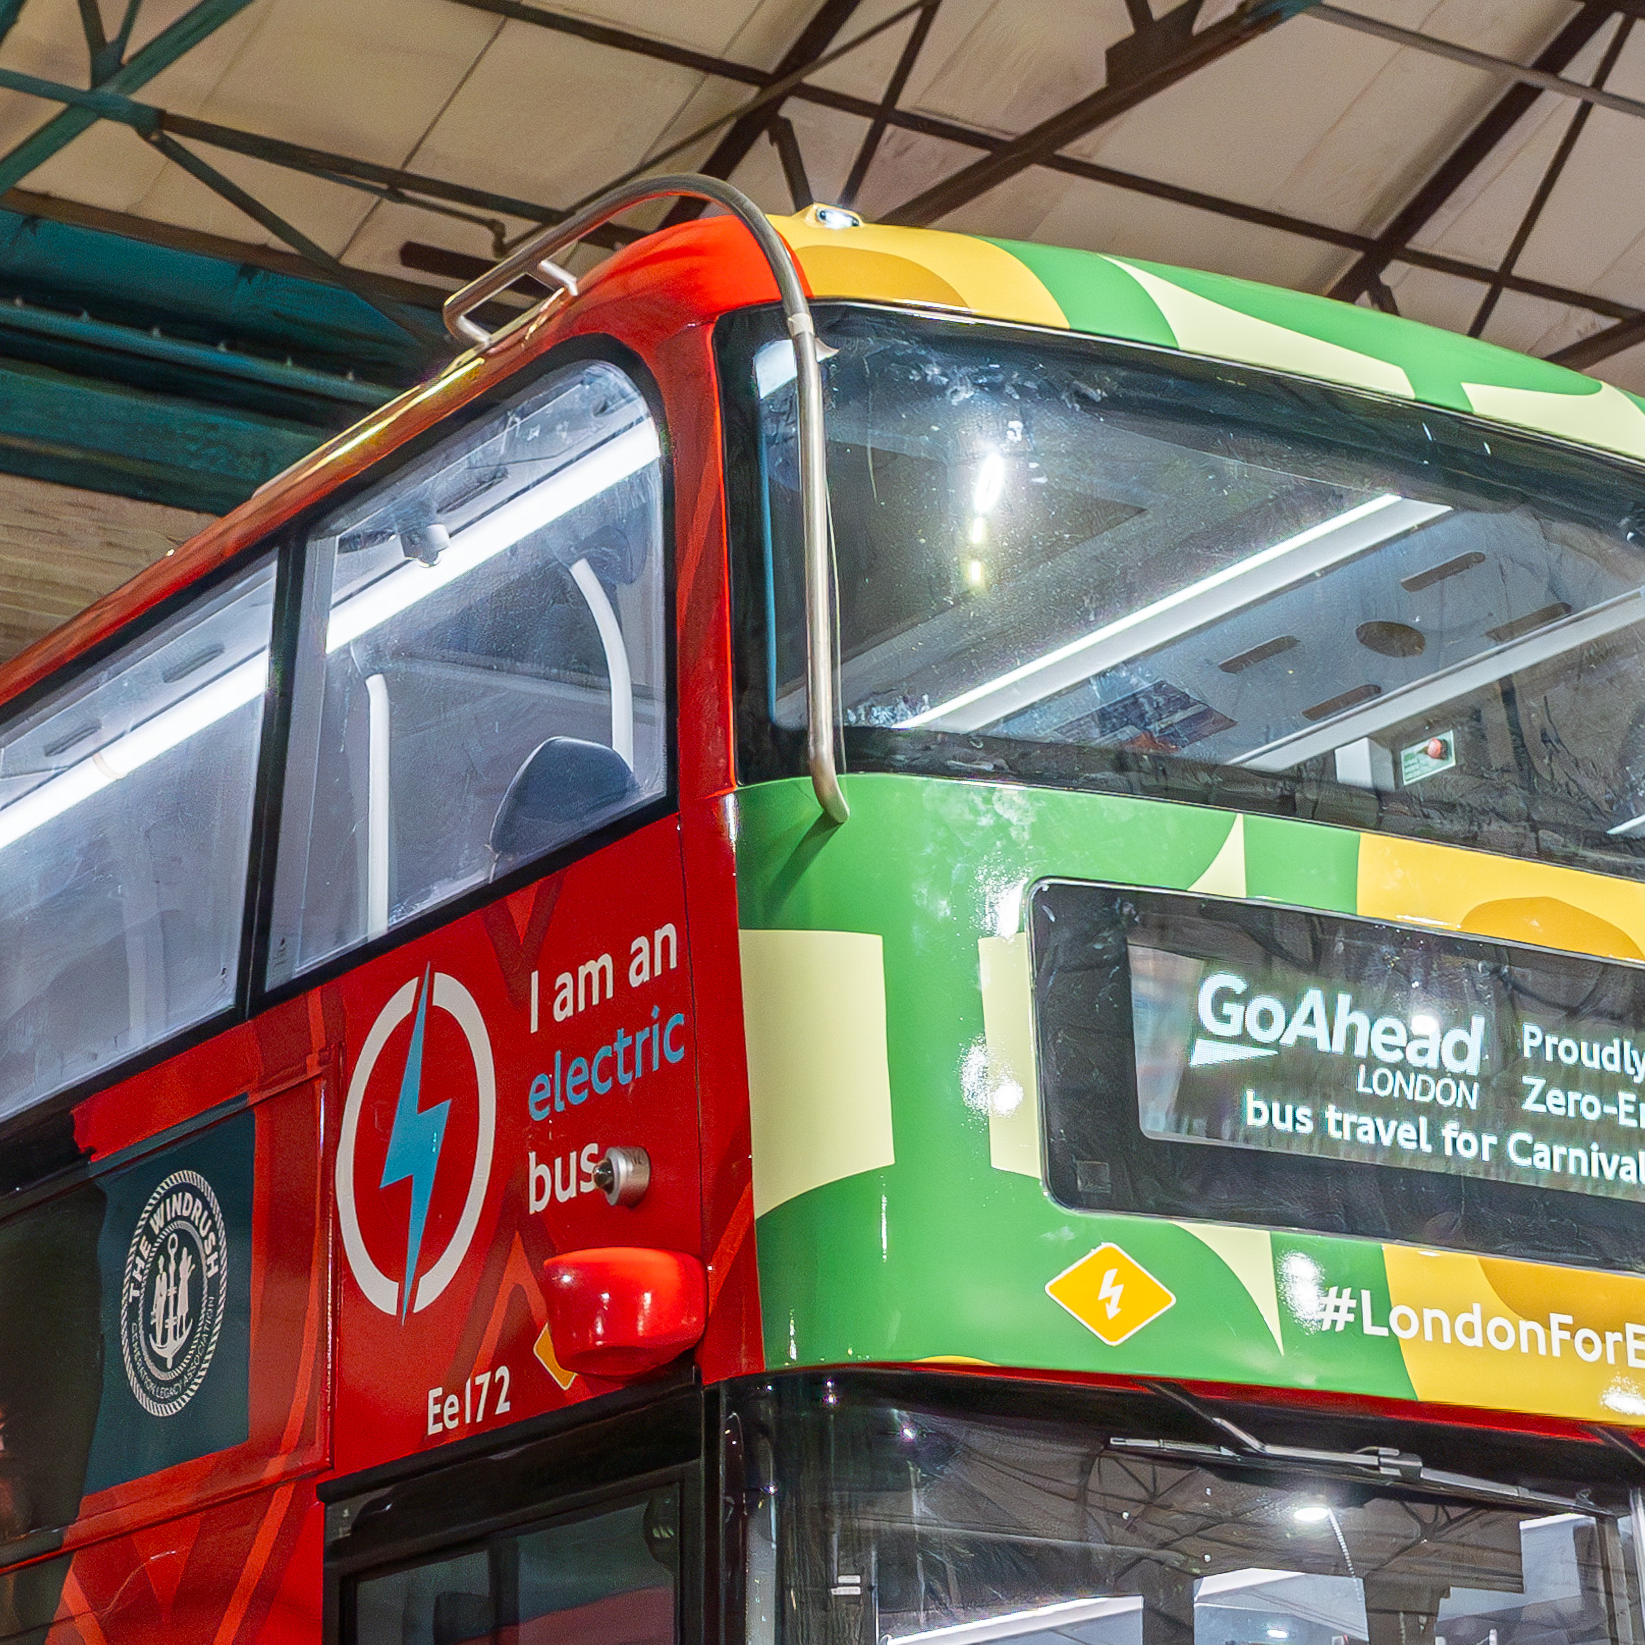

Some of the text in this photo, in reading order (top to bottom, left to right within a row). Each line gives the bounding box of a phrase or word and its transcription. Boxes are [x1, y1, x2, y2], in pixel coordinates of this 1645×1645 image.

[529, 922, 678, 1034] I am an
[1196, 971, 1485, 1076] GoAhead
[528, 1007, 685, 1121] electric
[1356, 1064, 1479, 1110] LONDON
[1245, 1091, 1314, 1136] bus
[1325, 1105, 1432, 1150] travel
[1442, 1120, 1498, 1164] for
[528, 1143, 600, 1214] bus
[149, 1191, 219, 1279] WINDRUSH
[427, 1366, 511, 1436] Ee172
